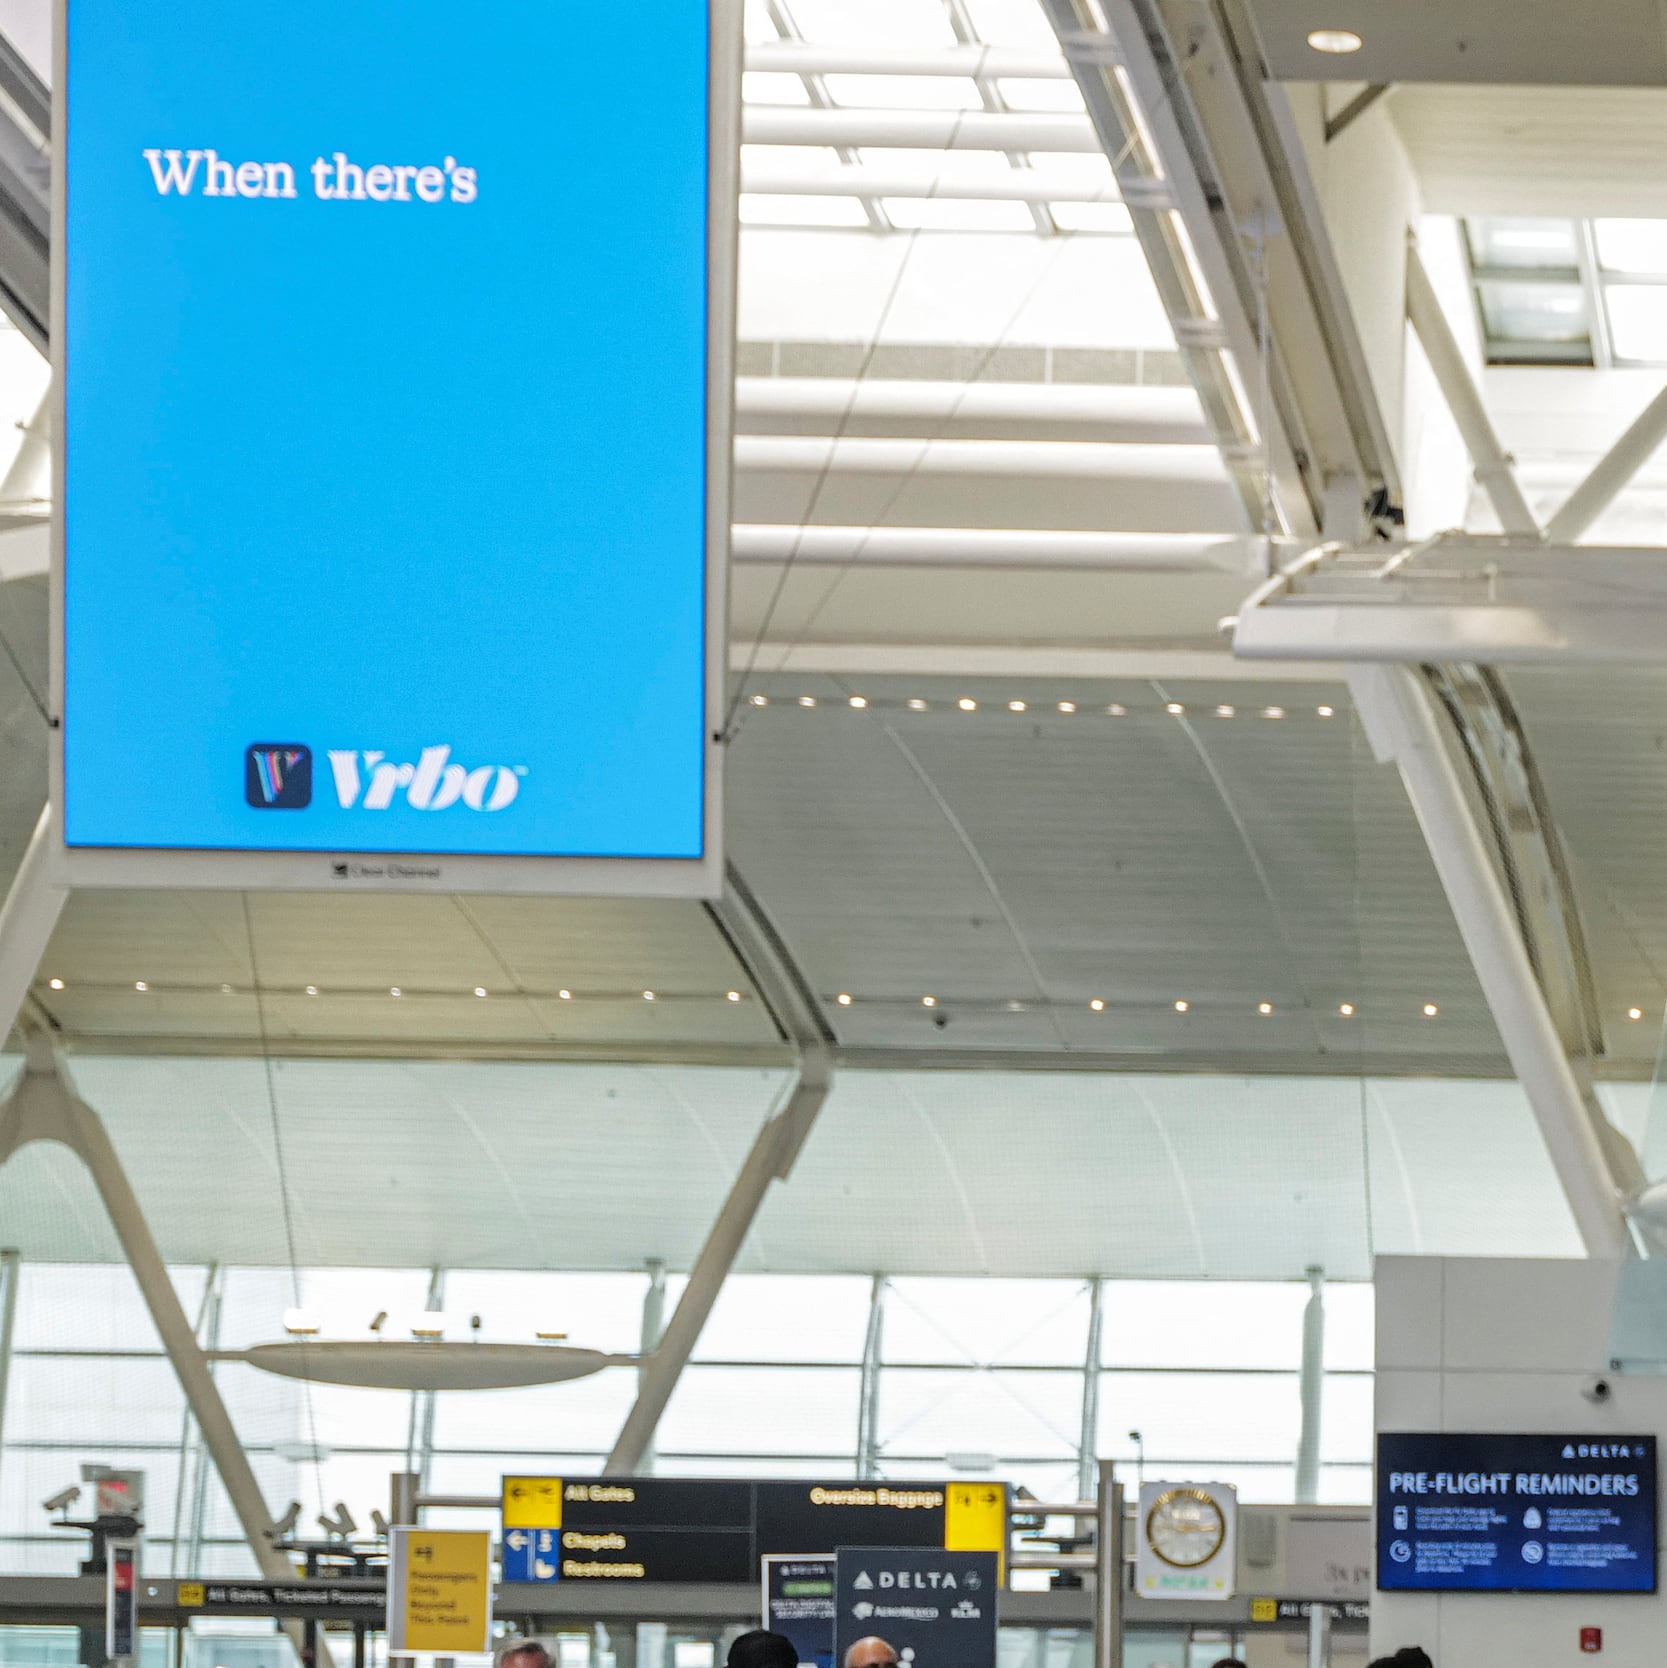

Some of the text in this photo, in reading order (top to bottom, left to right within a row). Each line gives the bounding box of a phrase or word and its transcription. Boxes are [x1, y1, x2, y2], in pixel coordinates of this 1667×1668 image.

[142, 148, 478, 203] When there's
[327, 744, 520, 812] Vrbo
[1578, 1444, 1631, 1458] DELTA
[565, 1485, 635, 1502] All Gates
[1389, 1472, 1639, 1496] PRE-FLIGHT REMINDERS
[810, 1487, 943, 1509] Oversize Baggage
[563, 1560, 645, 1578] Restrooms
[879, 1571, 957, 1589] DELTA
[331, 1589, 386, 1608] Passeng
